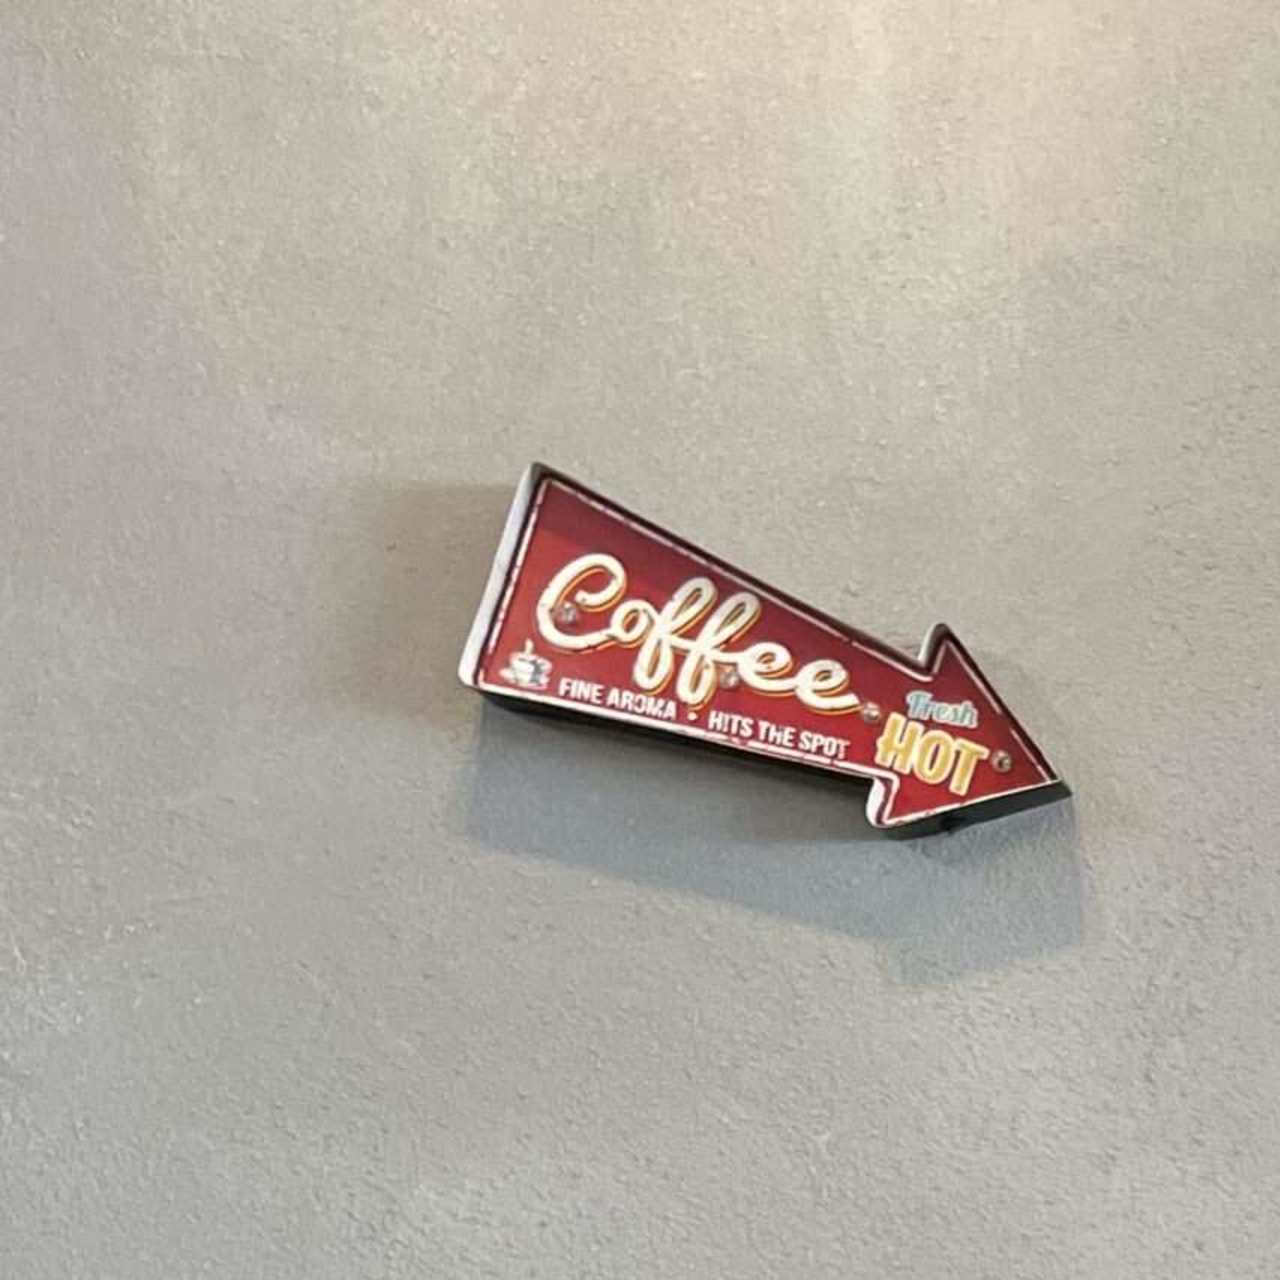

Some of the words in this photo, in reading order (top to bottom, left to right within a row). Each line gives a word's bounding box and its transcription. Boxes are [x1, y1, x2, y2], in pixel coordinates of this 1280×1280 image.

[536, 553, 864, 714] Coffee
[559, 677, 602, 705] FINE
[605, 688, 677, 720] AROMA
[707, 711, 753, 737] HITS
[758, 721, 795, 746] THE
[798, 730, 850, 759] SPOT
[906, 690, 978, 728] Fresh
[875, 712, 990, 796] HOT
